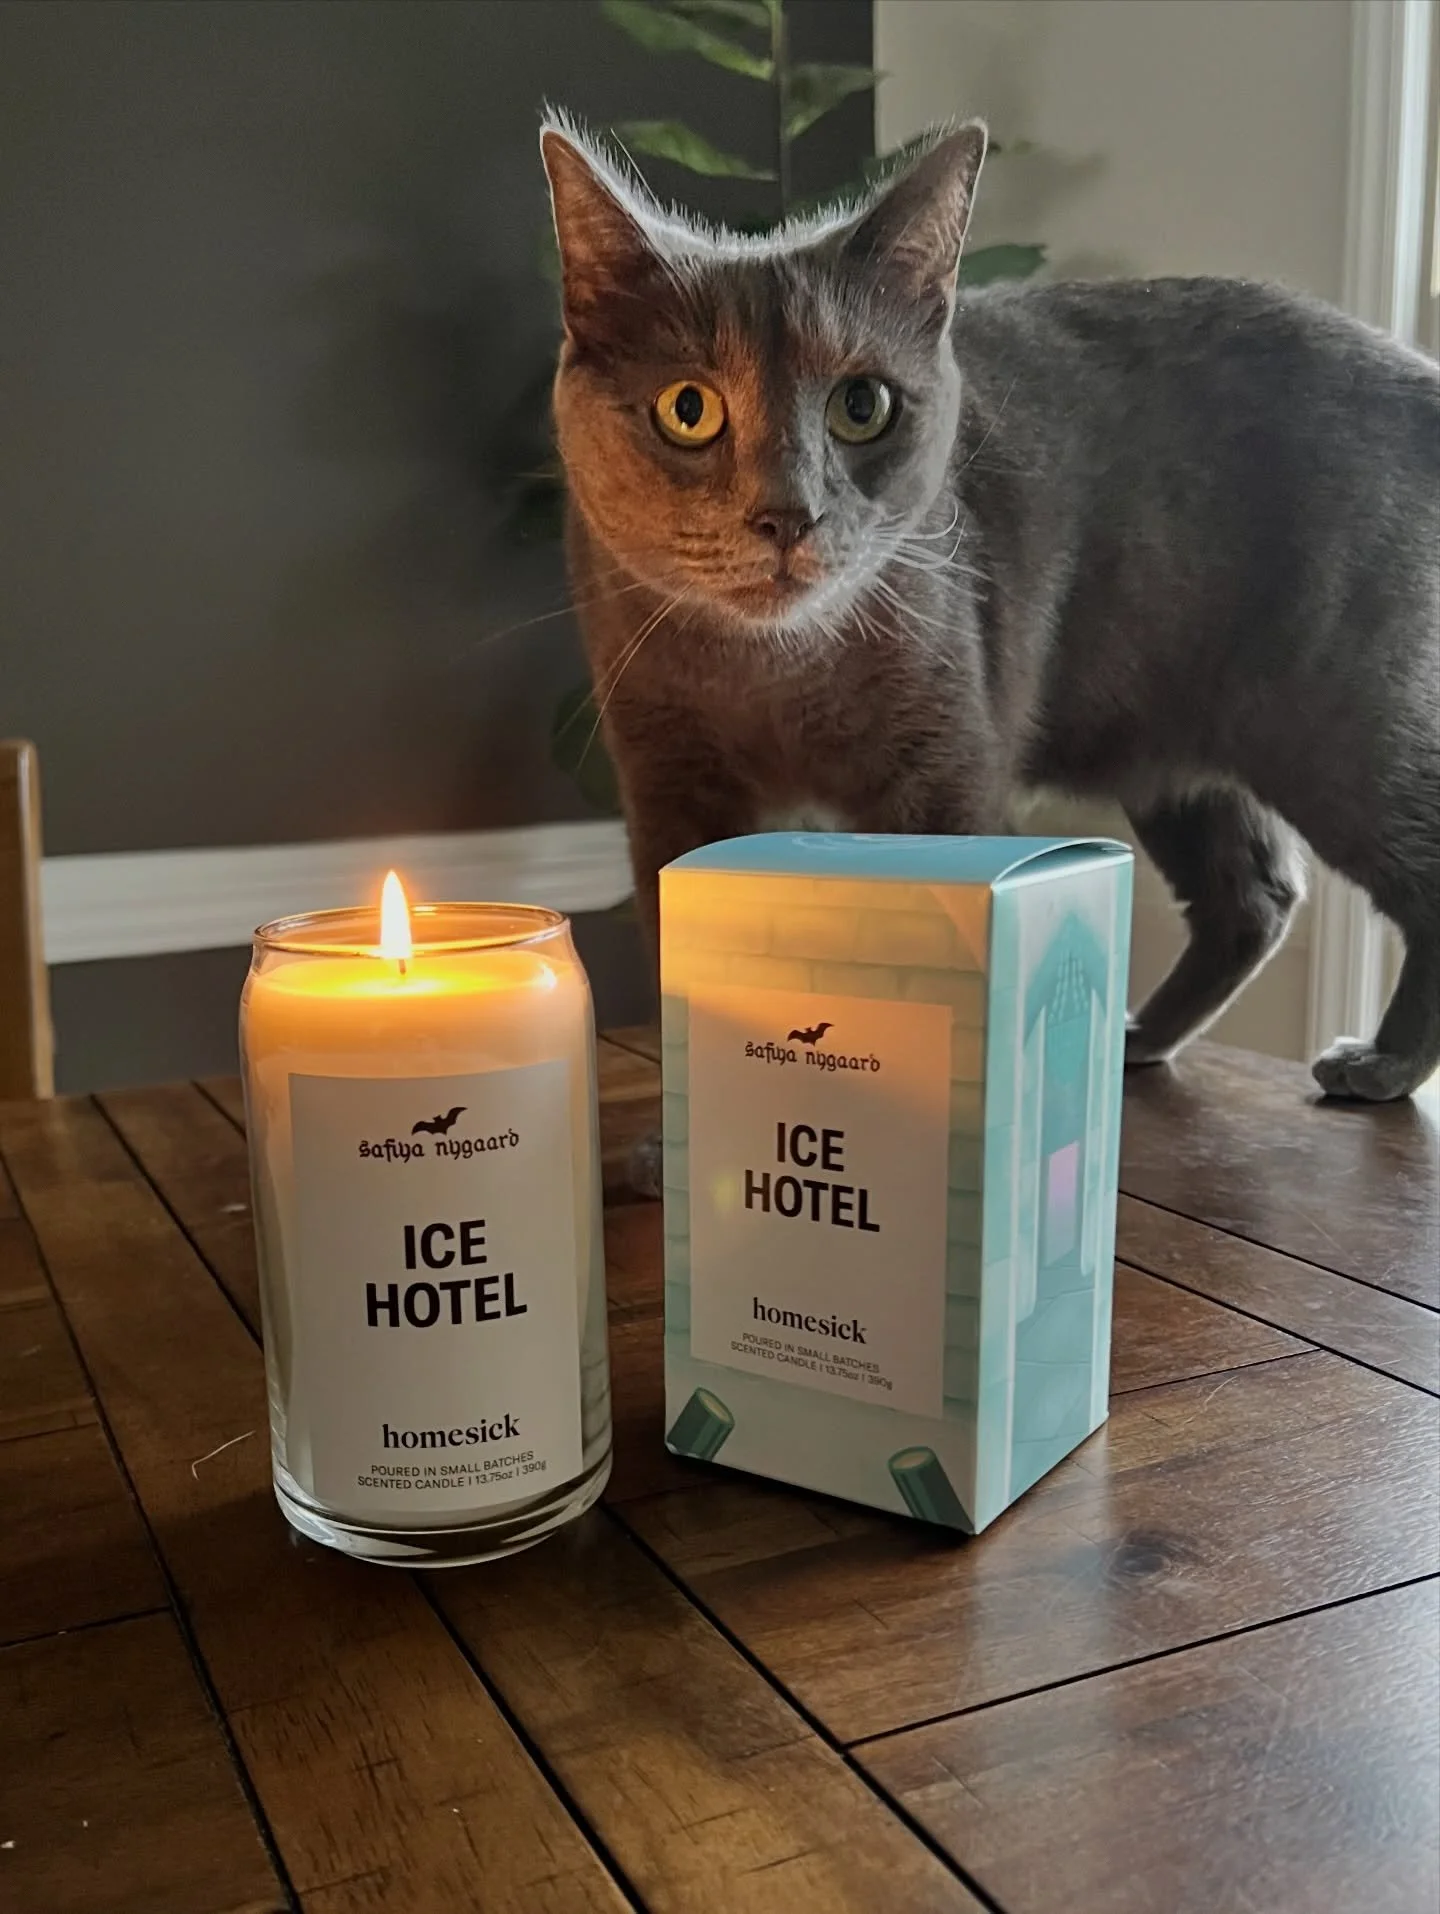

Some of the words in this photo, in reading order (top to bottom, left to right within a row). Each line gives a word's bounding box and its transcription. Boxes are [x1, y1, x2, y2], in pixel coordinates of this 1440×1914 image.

[359, 1138, 424, 1163] safiya
[435, 1128, 519, 1160] nygaard
[777, 1122, 844, 1172] ICE
[745, 1169, 880, 1232] HOTEL
[404, 1219, 487, 1269] ICE
[366, 1272, 527, 1328] HOTEL
[753, 1296, 868, 1344] homesick
[731, 1341, 775, 1360] SCENTED
[776, 1352, 816, 1371] CANDLE
[742, 1332, 782, 1350] POURED
[784, 1343, 795, 1353] IN
[797, 1346, 831, 1362] SMALL
[833, 1354, 880, 1373] BATCHES
[382, 1412, 520, 1449] homesick
[358, 1476, 412, 1489] SCENTED
[415, 1476, 465, 1489] CANDLE
[475, 1471, 513, 1486] 13.75oz
[522, 1461, 547, 1476] 390g
[371, 1464, 420, 1477] POURED
[423, 1465, 437, 1476] IN
[440, 1463, 481, 1476] SMALL
[483, 1450, 534, 1471] BATCHES
